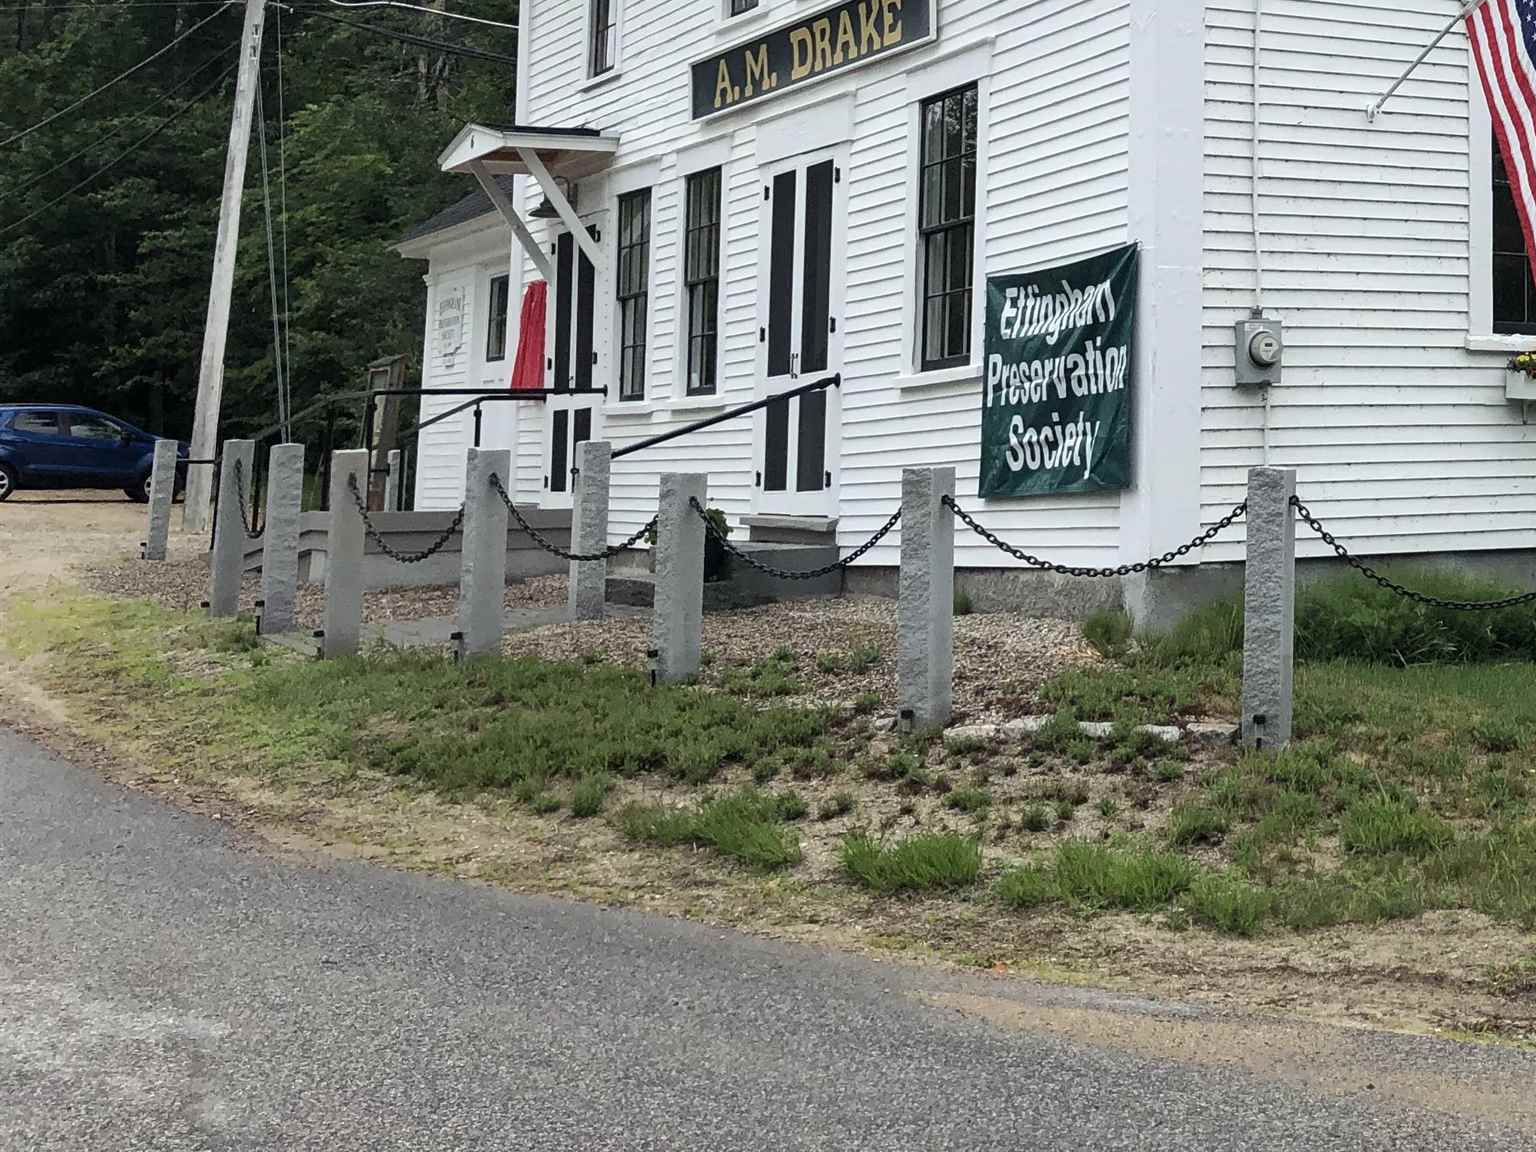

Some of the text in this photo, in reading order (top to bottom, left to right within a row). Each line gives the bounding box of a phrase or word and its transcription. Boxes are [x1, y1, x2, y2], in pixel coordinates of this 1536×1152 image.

[1000, 279, 1116, 346] Effingham
[987, 336, 1128, 408] Preservation
[1005, 410, 1101, 480] Society
